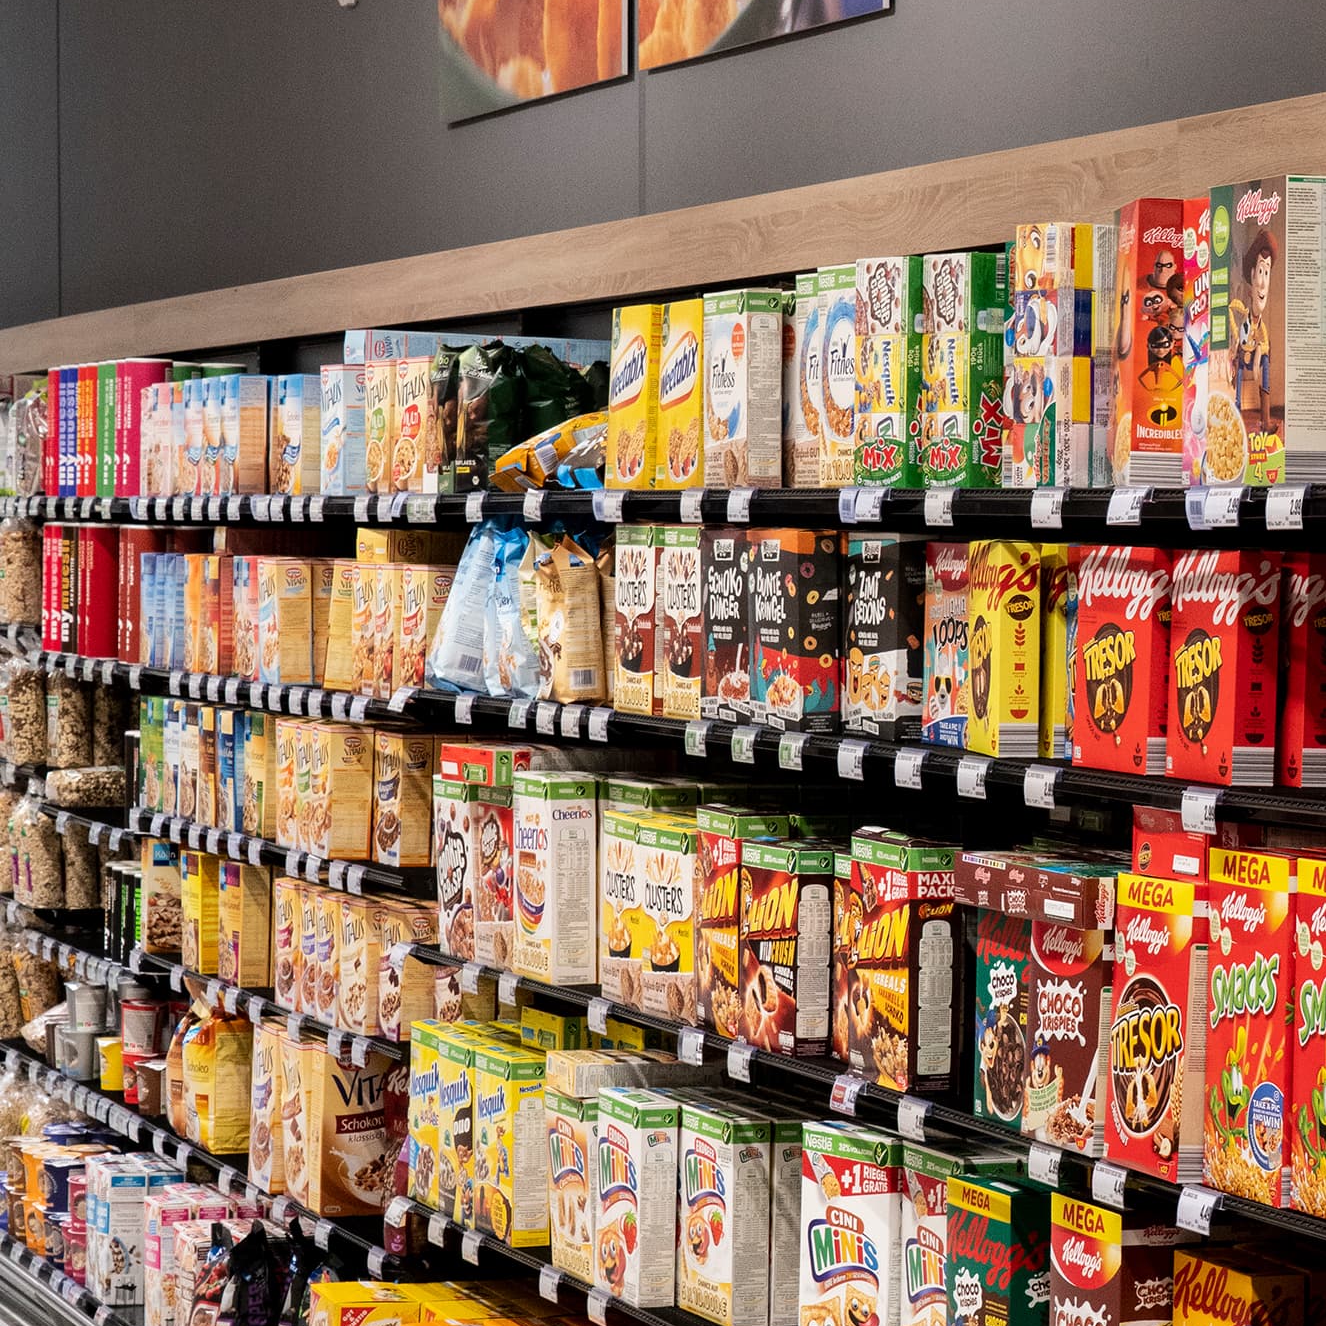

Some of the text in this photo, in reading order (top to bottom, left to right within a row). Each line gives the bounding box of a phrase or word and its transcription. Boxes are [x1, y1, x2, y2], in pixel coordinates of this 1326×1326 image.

[1236, 188, 1281, 224] Kellogg's
[881, 340, 896, 406] Nesquik
[947, 338, 960, 405] Nesquik
[1136, 424, 1183, 439] INCREDIBLES
[1254, 462, 1263, 482] 4
[756, 567, 782, 596] BUNTE
[755, 595, 786, 624] KRINGEL
[1084, 632, 1136, 681] TRESOR
[1175, 636, 1223, 689] TRESOR
[553, 808, 593, 821] Cheerios
[918, 874, 955, 886] MAXI
[1223, 855, 1271, 885] MEGA
[918, 886, 954, 898] PACK
[1128, 882, 1175, 907] MEGA
[1221, 891, 1267, 934] Kellogg's
[873, 973, 907, 994] CEREALS
[1039, 983, 1082, 1017] CHOCO
[1042, 1011, 1076, 1034] KRISPIES
[1112, 1005, 1182, 1075] TRESOR
[477, 1086, 506, 1120] Nesquik
[804, 1132, 833, 1152] Nestlé
[863, 1180, 888, 1193] GRATIS
[962, 1186, 990, 1211] MEGA
[831, 1209, 859, 1230] CINI
[1063, 1202, 1105, 1233] MEGA
[957, 1280, 979, 1297] choco
